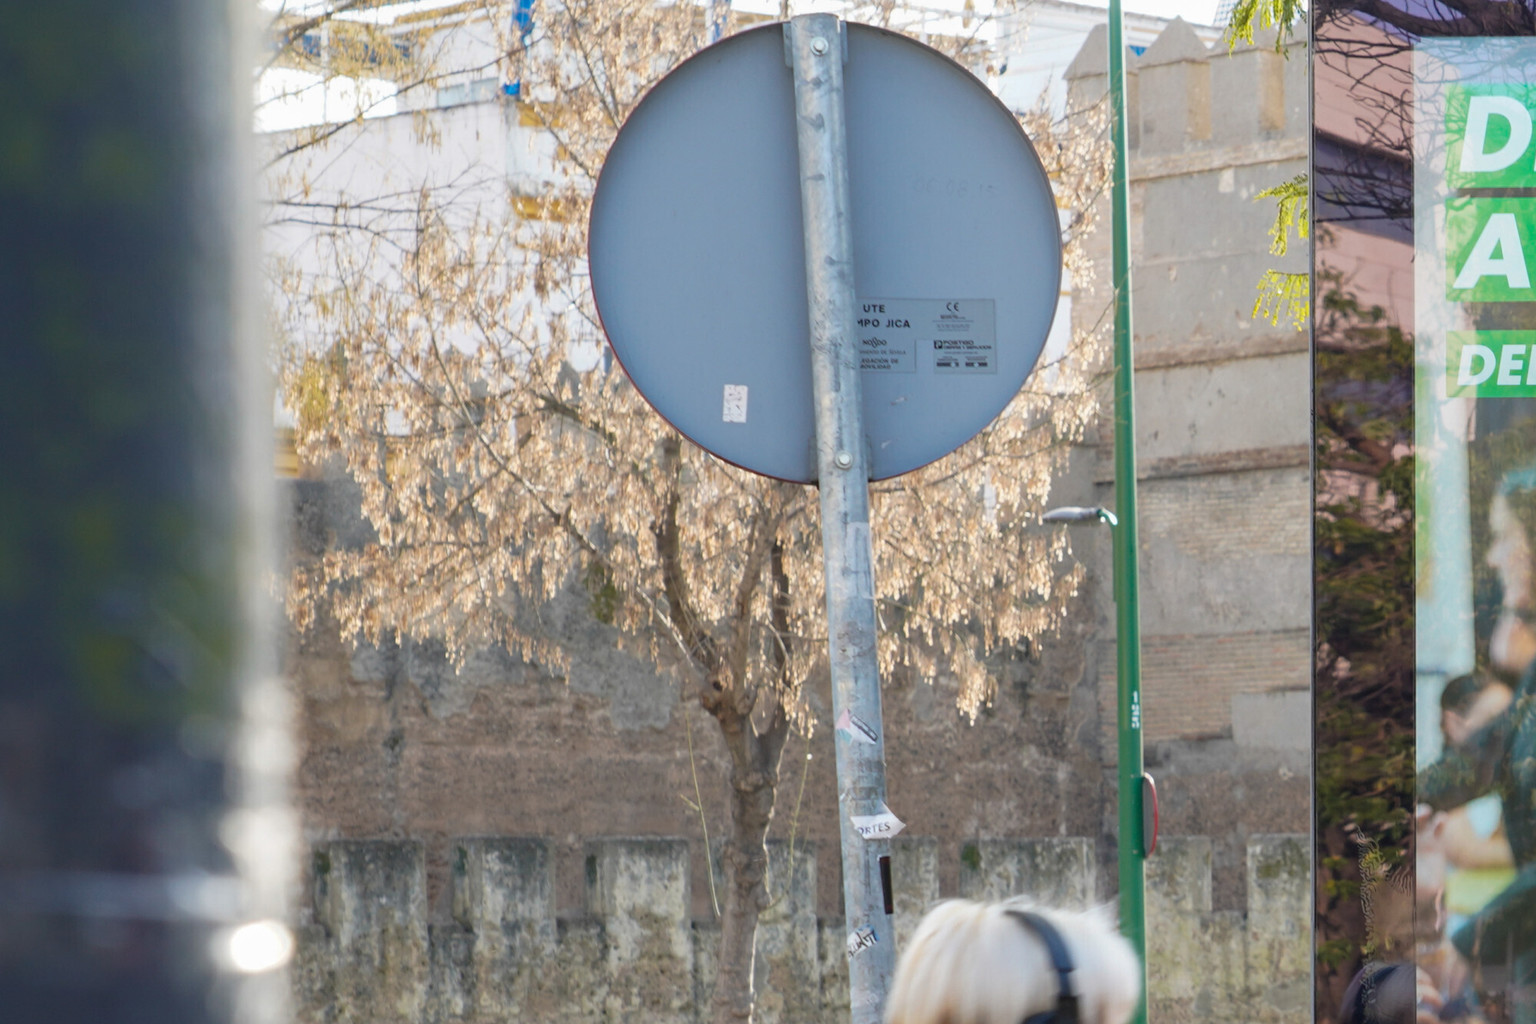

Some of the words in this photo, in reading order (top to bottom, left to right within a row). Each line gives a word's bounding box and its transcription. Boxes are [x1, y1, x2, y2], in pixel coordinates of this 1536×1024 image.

[863, 304, 885, 313] UTE
[857, 319, 880, 328] MPO
[886, 319, 911, 329] JICA
